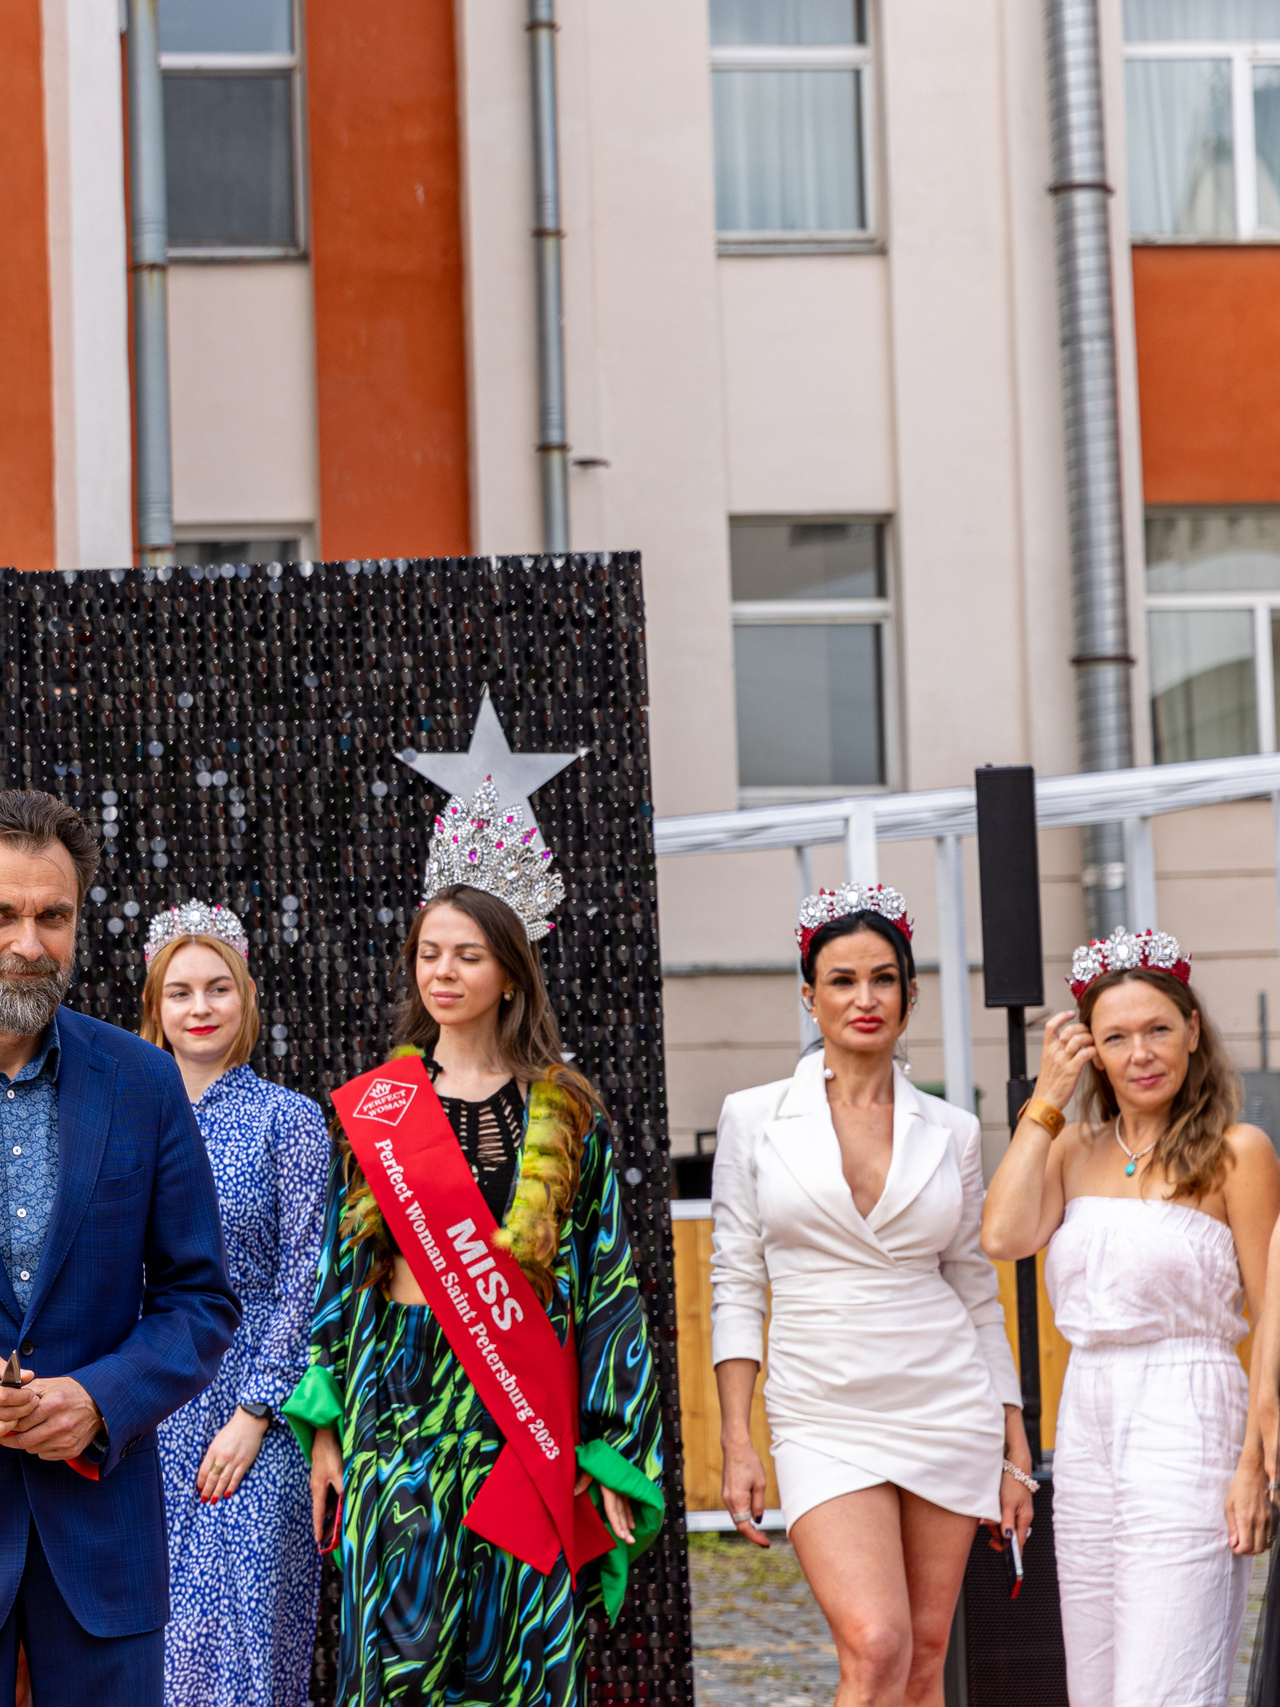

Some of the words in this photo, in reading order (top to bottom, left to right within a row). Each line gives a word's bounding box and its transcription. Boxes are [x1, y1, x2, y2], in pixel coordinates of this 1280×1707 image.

[363, 1089, 407, 1112] PERFECT
[368, 1098, 407, 1117] WOMAN
[374, 1138, 414, 1203] Perfect
[405, 1200, 447, 1273] Woman
[440, 1272, 478, 1323] Saint
[469, 1321, 535, 1422] Petersburg
[528, 1418, 561, 1461] 2023
[445, 1217, 524, 1331] MISS
